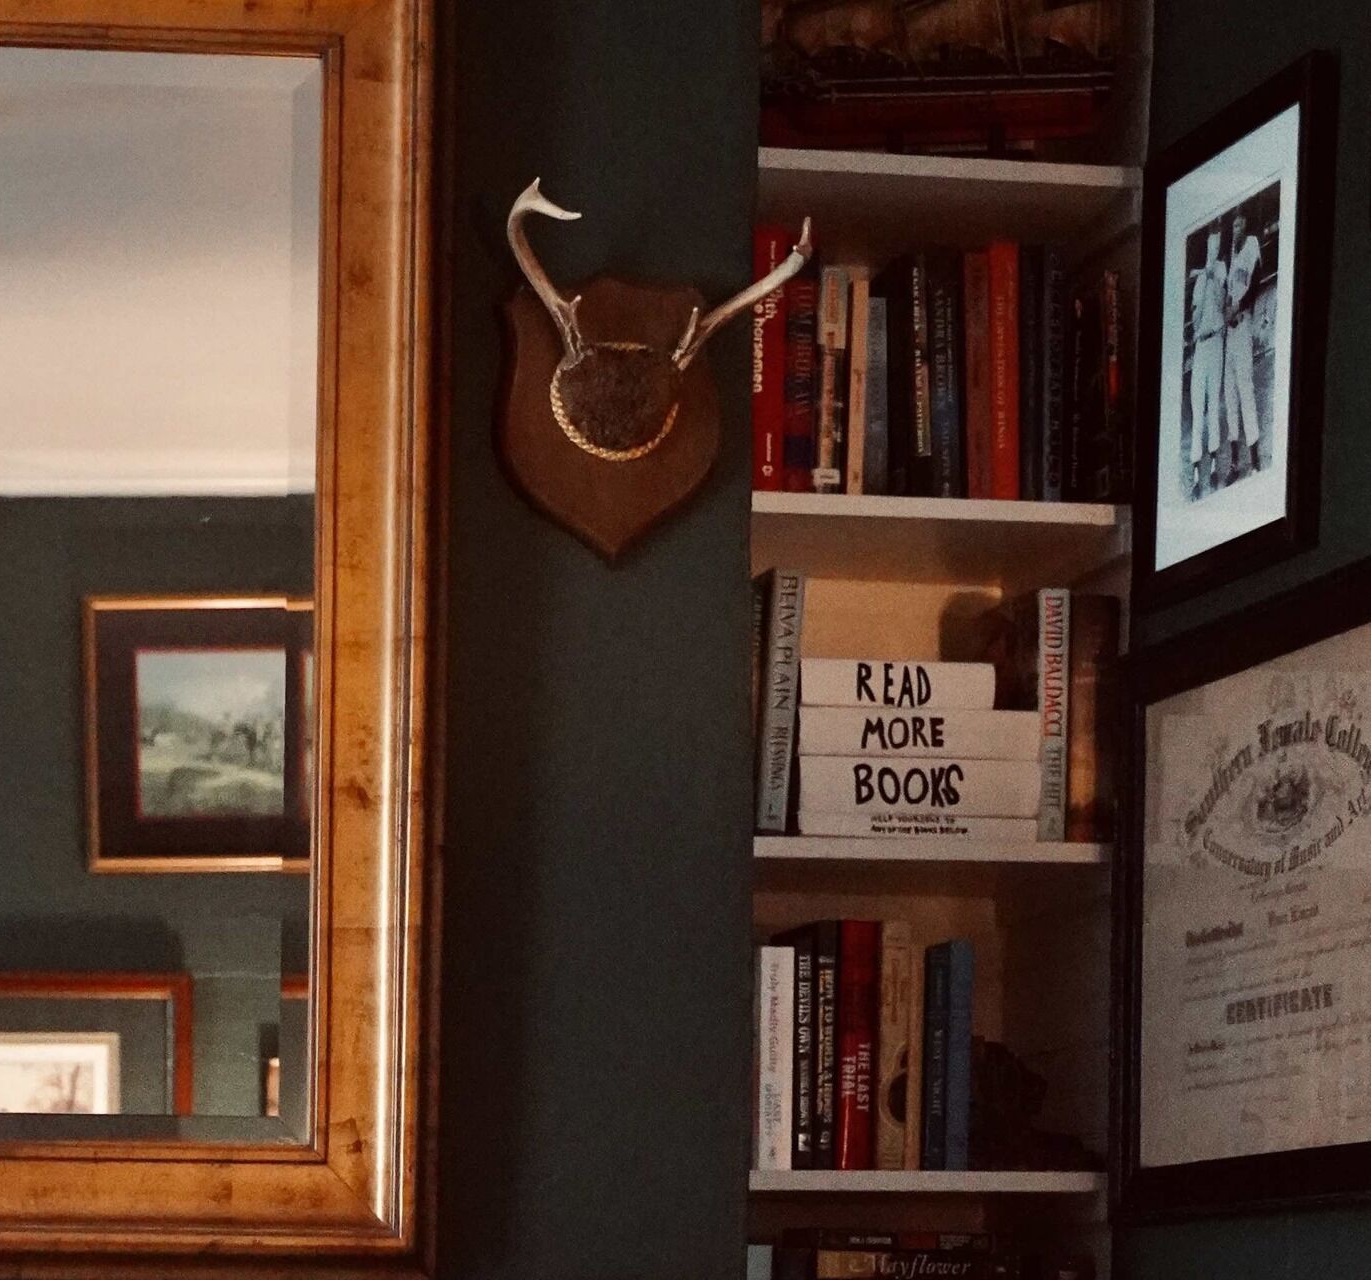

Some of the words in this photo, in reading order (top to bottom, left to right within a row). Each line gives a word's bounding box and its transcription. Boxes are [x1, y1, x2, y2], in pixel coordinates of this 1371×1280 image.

[932, 288, 947, 350] SANDRA
[752, 317, 766, 394] horsemen
[934, 353, 948, 412] BROWN
[778, 575, 799, 640] BELVA
[1044, 595, 1064, 649] DAVID
[772, 646, 794, 711] PLAIN
[856, 662, 932, 708] READ
[1043, 653, 1064, 738] BALDACCI
[860, 716, 945, 750] MORE
[853, 763, 965, 808] BOOKS
[797, 955, 812, 979] THE
[1226, 983, 1334, 1025] CERTIFICATE
[797, 1026, 812, 1054] OWN
[856, 1041, 872, 1071] THE
[840, 1055, 857, 1100] TRIAL
[855, 1073, 871, 1114] LAST
[848, 1252, 973, 1280] Mayflower
